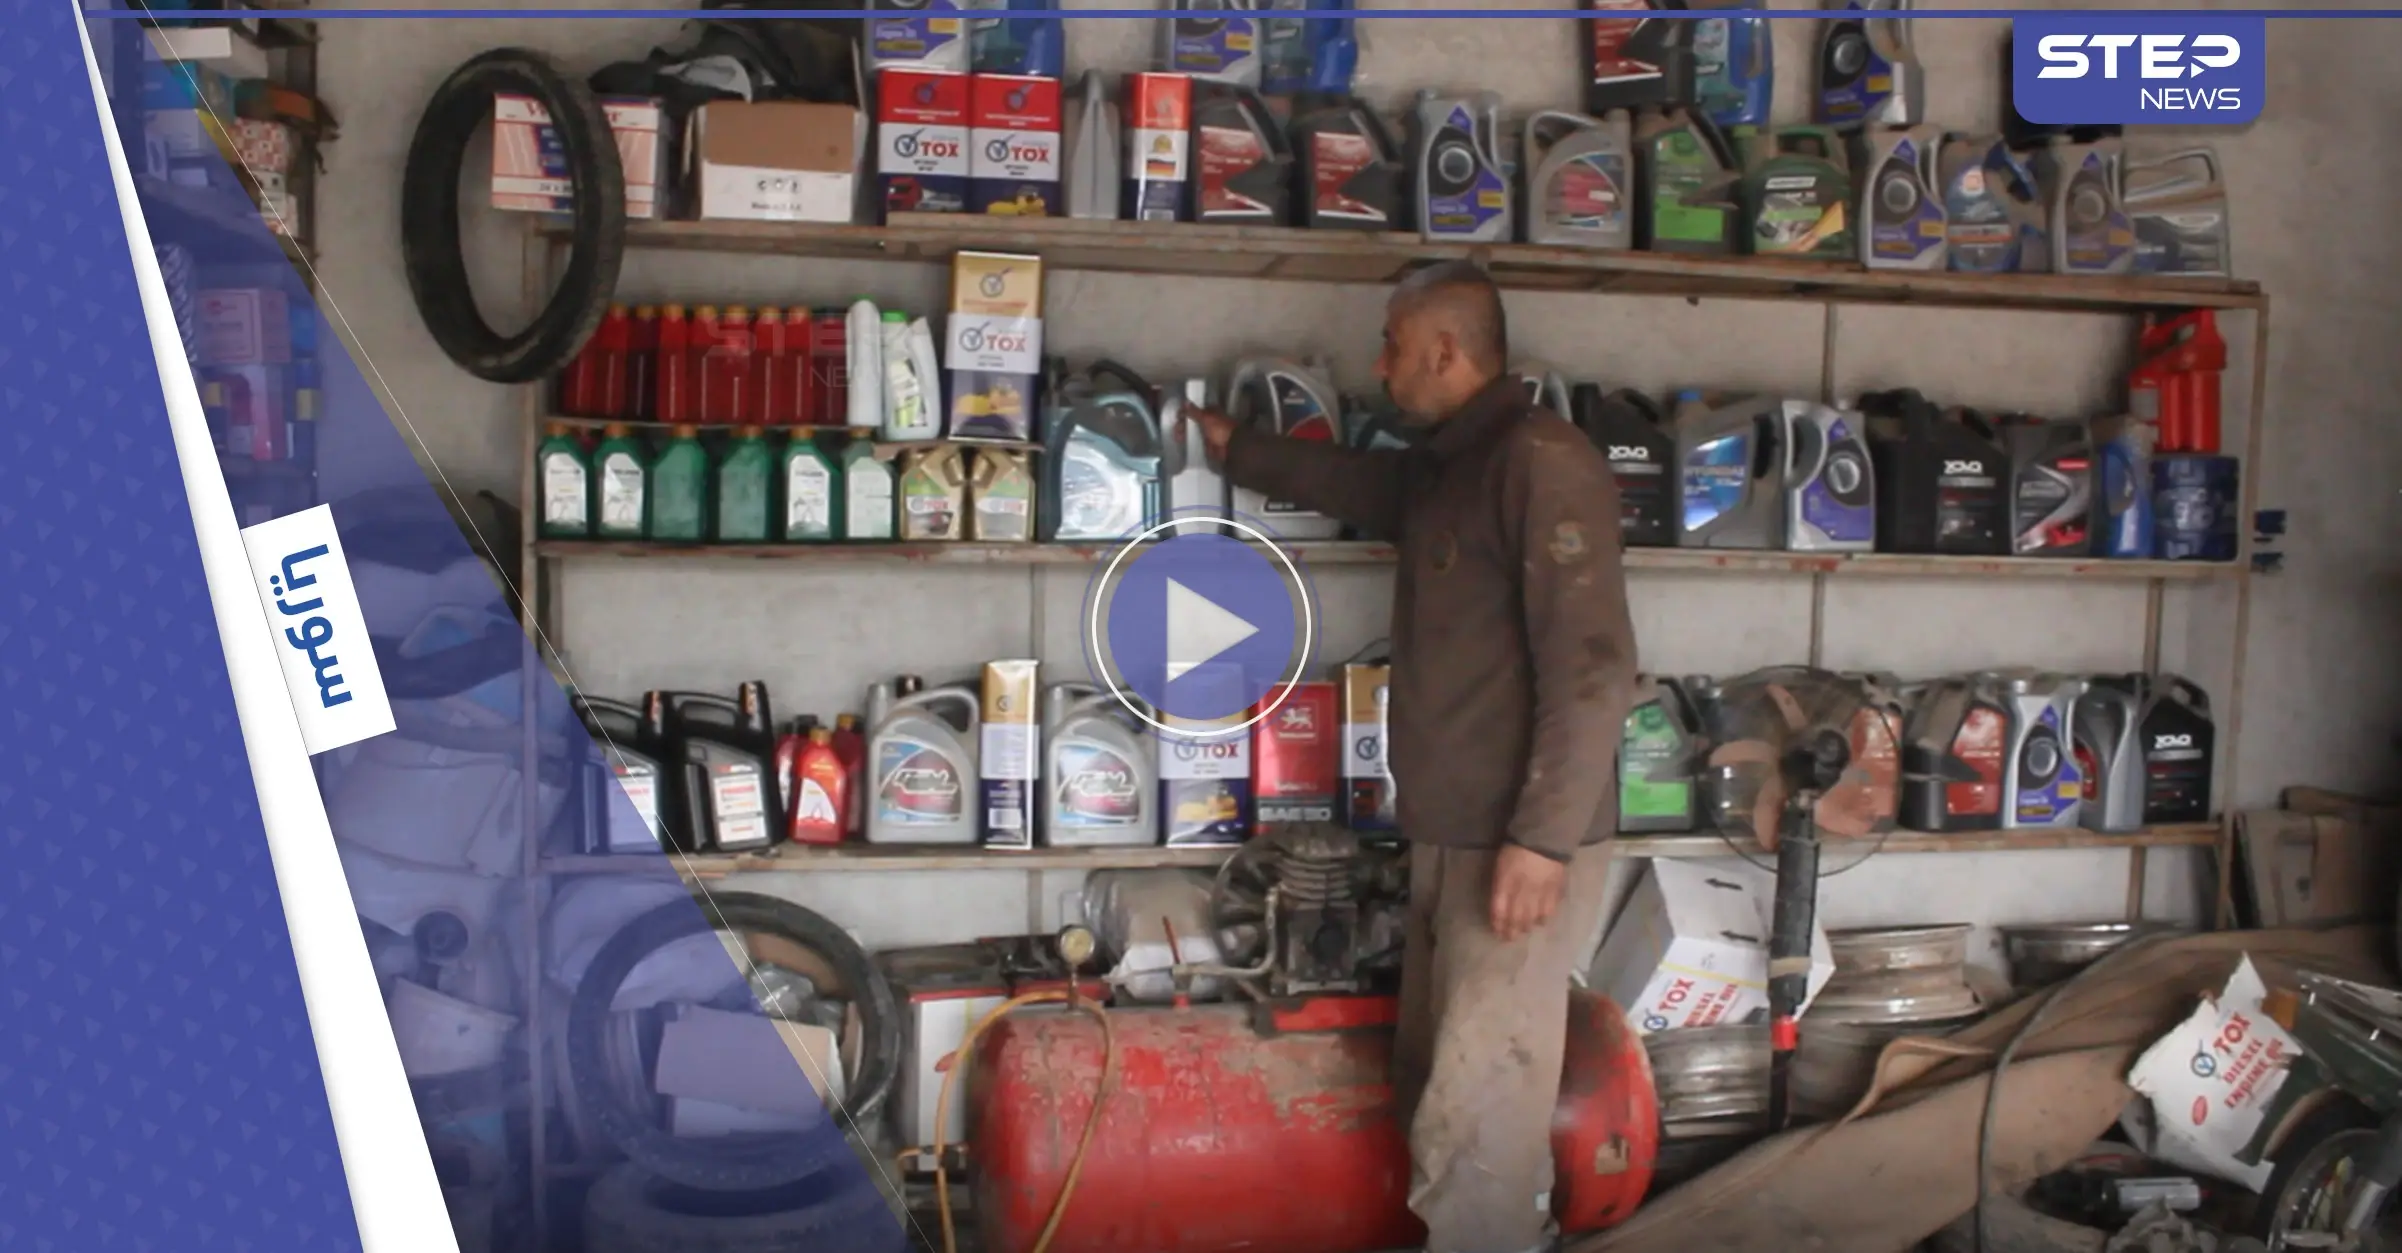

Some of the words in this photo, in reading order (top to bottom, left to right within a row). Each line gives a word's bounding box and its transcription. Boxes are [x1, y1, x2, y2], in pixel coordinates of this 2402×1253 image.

[920, 141, 960, 158] TOX
[1011, 147, 1050, 163] TOX
[986, 334, 1029, 352] TOX
[1199, 742, 1239, 759] TOX
[1658, 978, 1696, 1011] TOX
[2213, 1013, 2252, 1054] TOX
[2222, 1038, 2264, 1086] DIESEL
